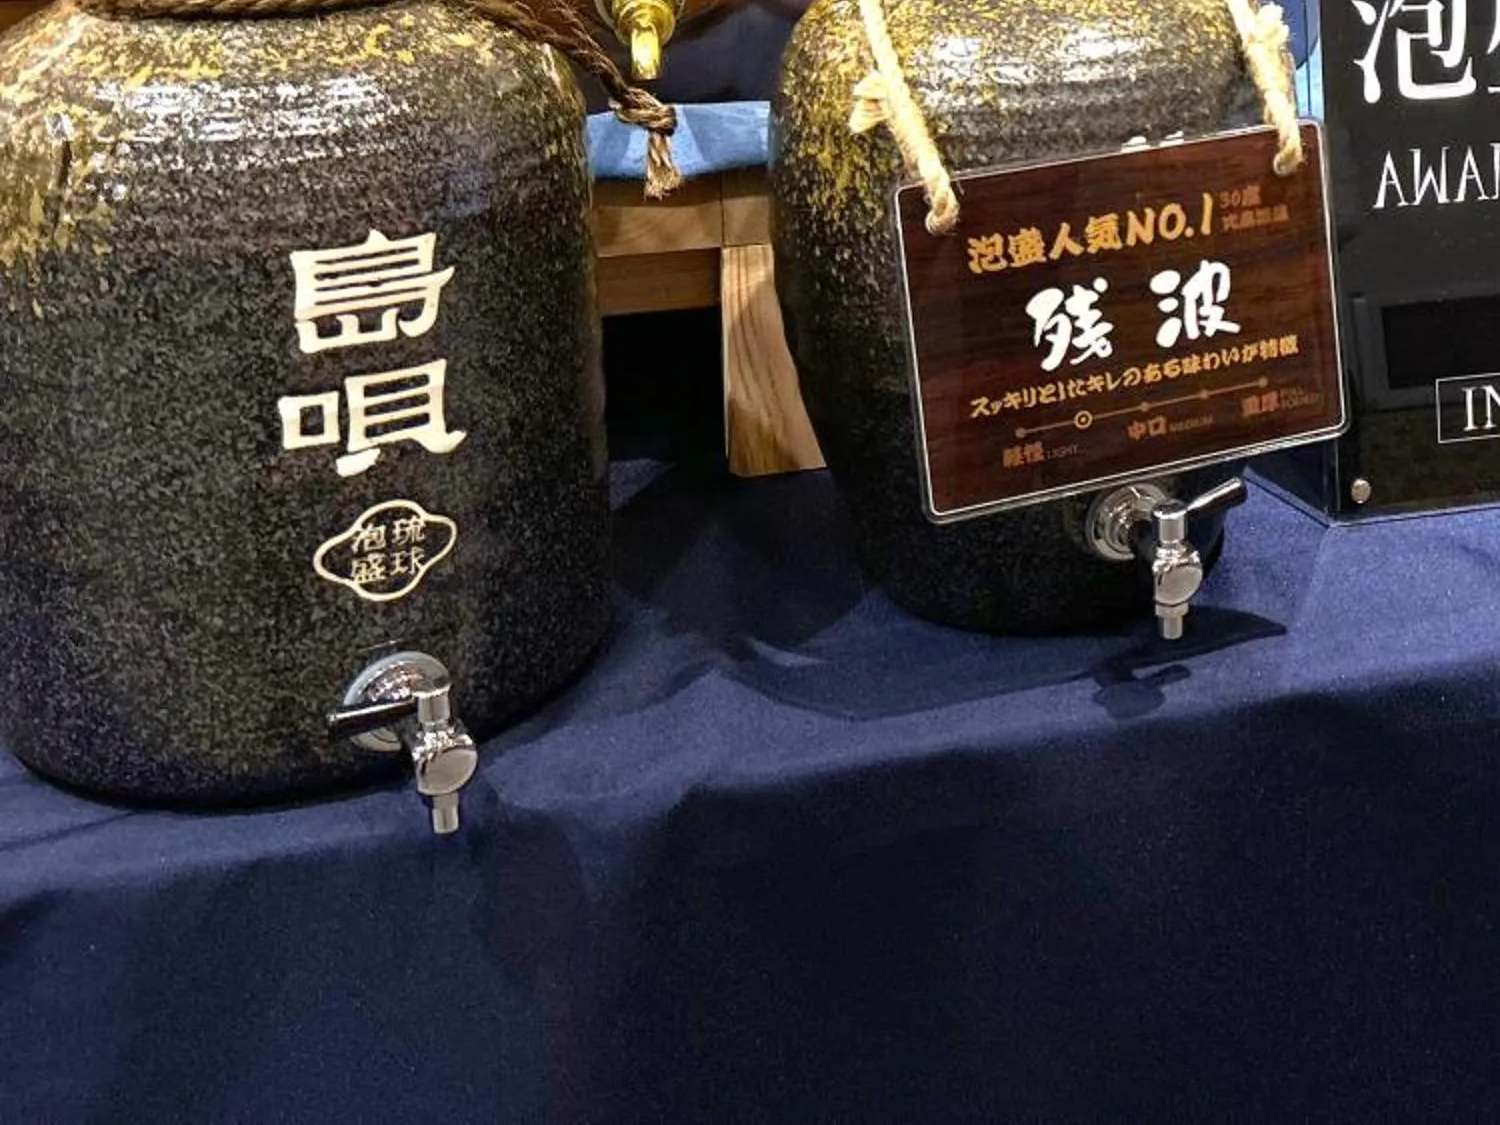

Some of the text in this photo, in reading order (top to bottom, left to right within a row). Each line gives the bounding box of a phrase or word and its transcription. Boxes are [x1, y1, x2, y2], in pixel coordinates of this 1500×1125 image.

[967, 193, 1214, 274] 泡盛人気NO.1
[1024, 259, 1241, 372] 残波
[970, 334, 1299, 419] スッキリとしたキレのある味わいが特徴
